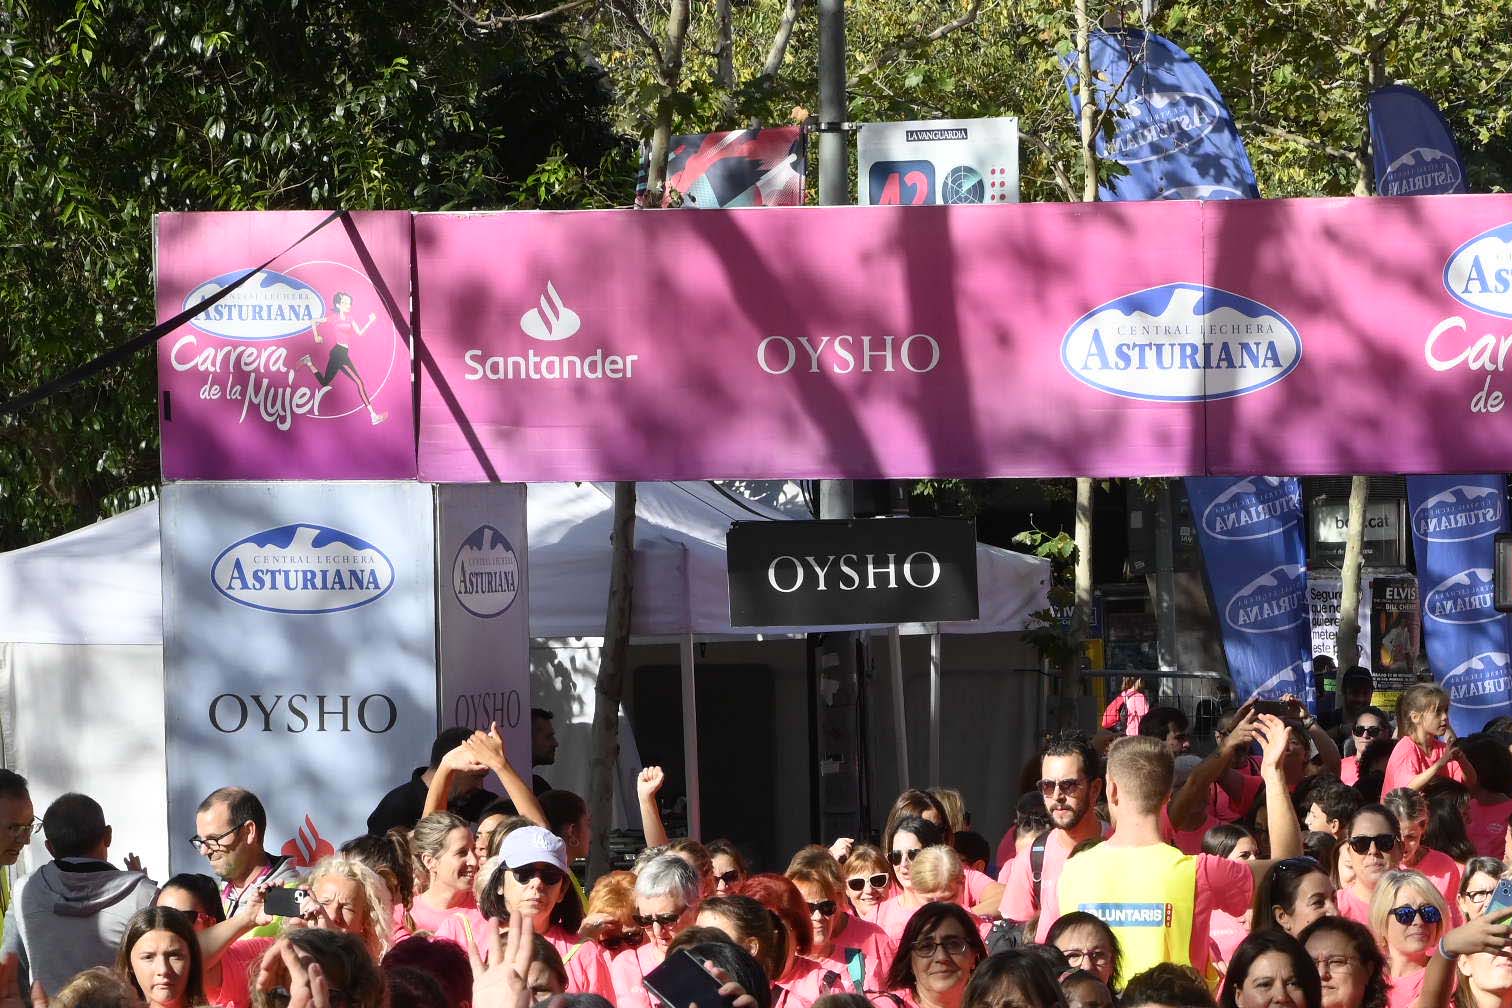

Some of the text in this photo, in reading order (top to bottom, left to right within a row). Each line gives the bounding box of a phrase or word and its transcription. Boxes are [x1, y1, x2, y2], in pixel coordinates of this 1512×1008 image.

[907, 128, 967, 141] LA VANGUARDIA
[1116, 323, 1275, 335] CENTRAL LECHERA
[171, 335, 288, 373] Carrera
[464, 347, 638, 381] Santander
[757, 334, 940, 374] OYSHO
[1081, 330, 1283, 371] ASTURIANA
[199, 369, 332, 431] de la Mujer
[1470, 374, 1503, 413] de
[226, 557, 382, 591] ASTURIANA
[253, 555, 376, 565] CENTRAL LECHERA
[458, 560, 516, 595] ASTURIANA
[768, 551, 941, 593] OYSHO
[1386, 587, 1416, 600] ELVIS
[1311, 618, 1343, 628] quiere
[208, 693, 398, 734] OYSHO
[455, 689, 521, 730] OYSHO
